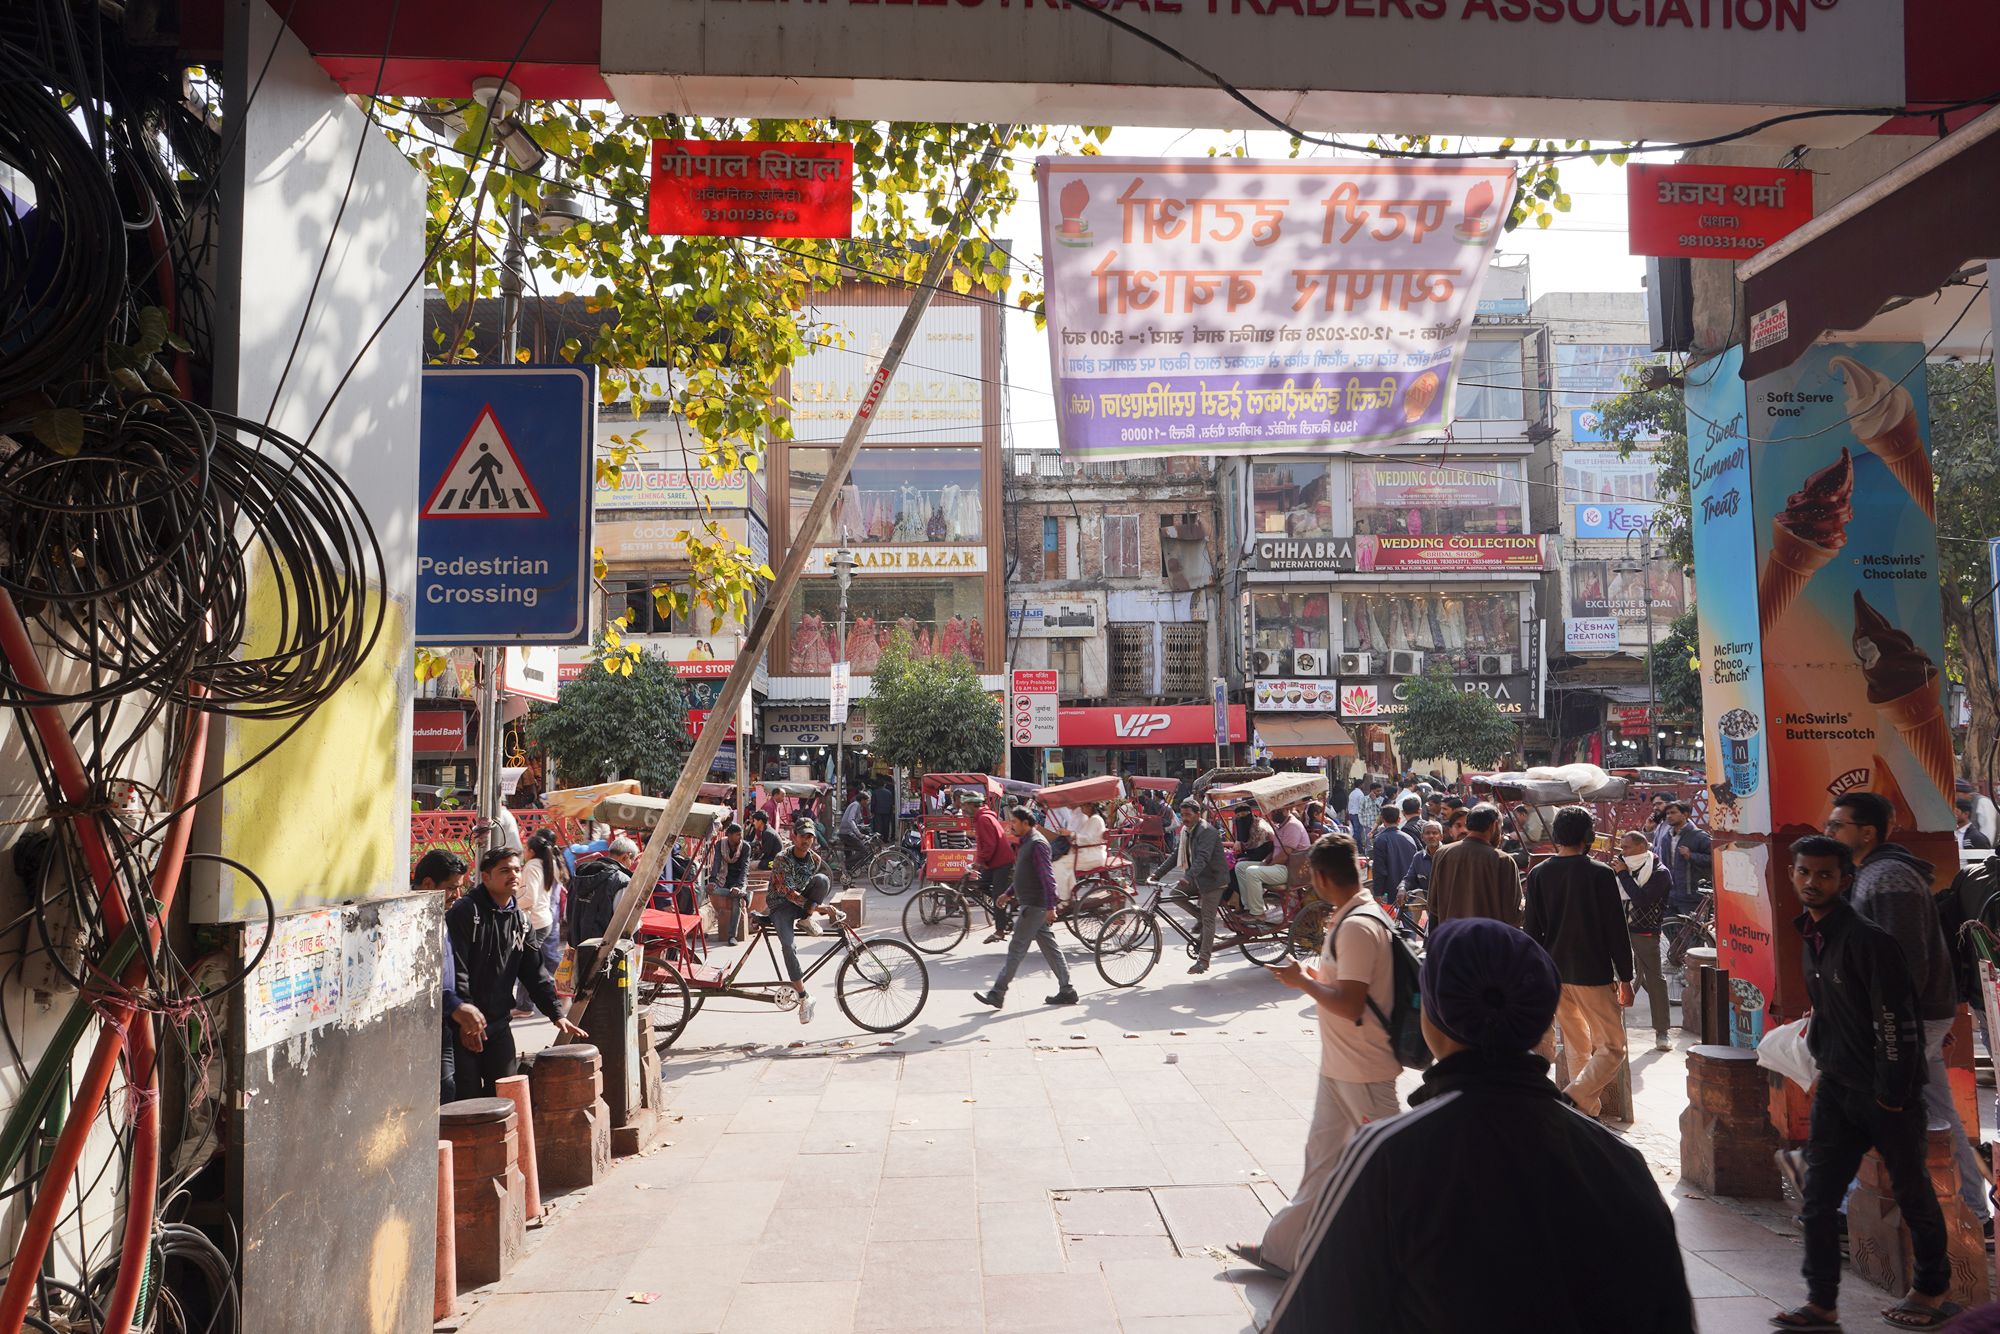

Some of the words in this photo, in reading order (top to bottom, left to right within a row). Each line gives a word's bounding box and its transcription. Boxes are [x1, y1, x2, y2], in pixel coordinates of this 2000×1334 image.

[661, 147, 750, 177] गोपाल
[758, 150, 842, 180] सिंघल
[1657, 180, 1726, 205] अजय
[1733, 178, 1786, 208] शर्मा
[1698, 215, 1739, 228] (प्रधान)
[1678, 235, 1765, 249] 9810331405
[862, 372, 886, 414] STOP
[1767, 392, 1795, 402] Soft
[1797, 392, 1834, 402] Serve
[1704, 413, 1744, 451] Sweet
[1692, 448, 1745, 490] Summer
[645, 470, 745, 490] CREATIONS
[1376, 470, 1427, 486] WEDDING
[1429, 470, 1497, 486] COLLECTION
[1700, 488, 1741, 524] Treats
[1260, 540, 1352, 559] CHHABRA
[1380, 538, 1443, 548] WEDDING
[1448, 538, 1536, 548] COLLECTION
[417, 556, 549, 576] Pedestrian
[906, 551, 977, 567] BAZAR
[1270, 560, 1342, 569] INTERNATIONAL
[1863, 569, 1928, 580] Chocolate
[426, 583, 538, 608] Crossing
[1585, 600, 1636, 608] EXCLUSIVE
[1611, 608, 1647, 617] SAREES
[1575, 622, 1615, 633] KESHAV
[1567, 632, 1617, 641] CREATIONS
[1713, 642, 1754, 656] McFlurry
[1713, 658, 1743, 672] Choco
[1714, 669, 1748, 684] Crunch
[778, 713, 831, 722] MODER
[1113, 713, 1171, 736] VIP
[413, 727, 442, 736] ndusInd
[442, 727, 462, 736] Bank
[799, 734, 818, 742] 47
[1785, 727, 1875, 740] Butterscotch
[1831, 770, 1868, 795] NEW
[1728, 923, 1770, 946] McFlurry
[1730, 938, 1754, 954] Oreo
